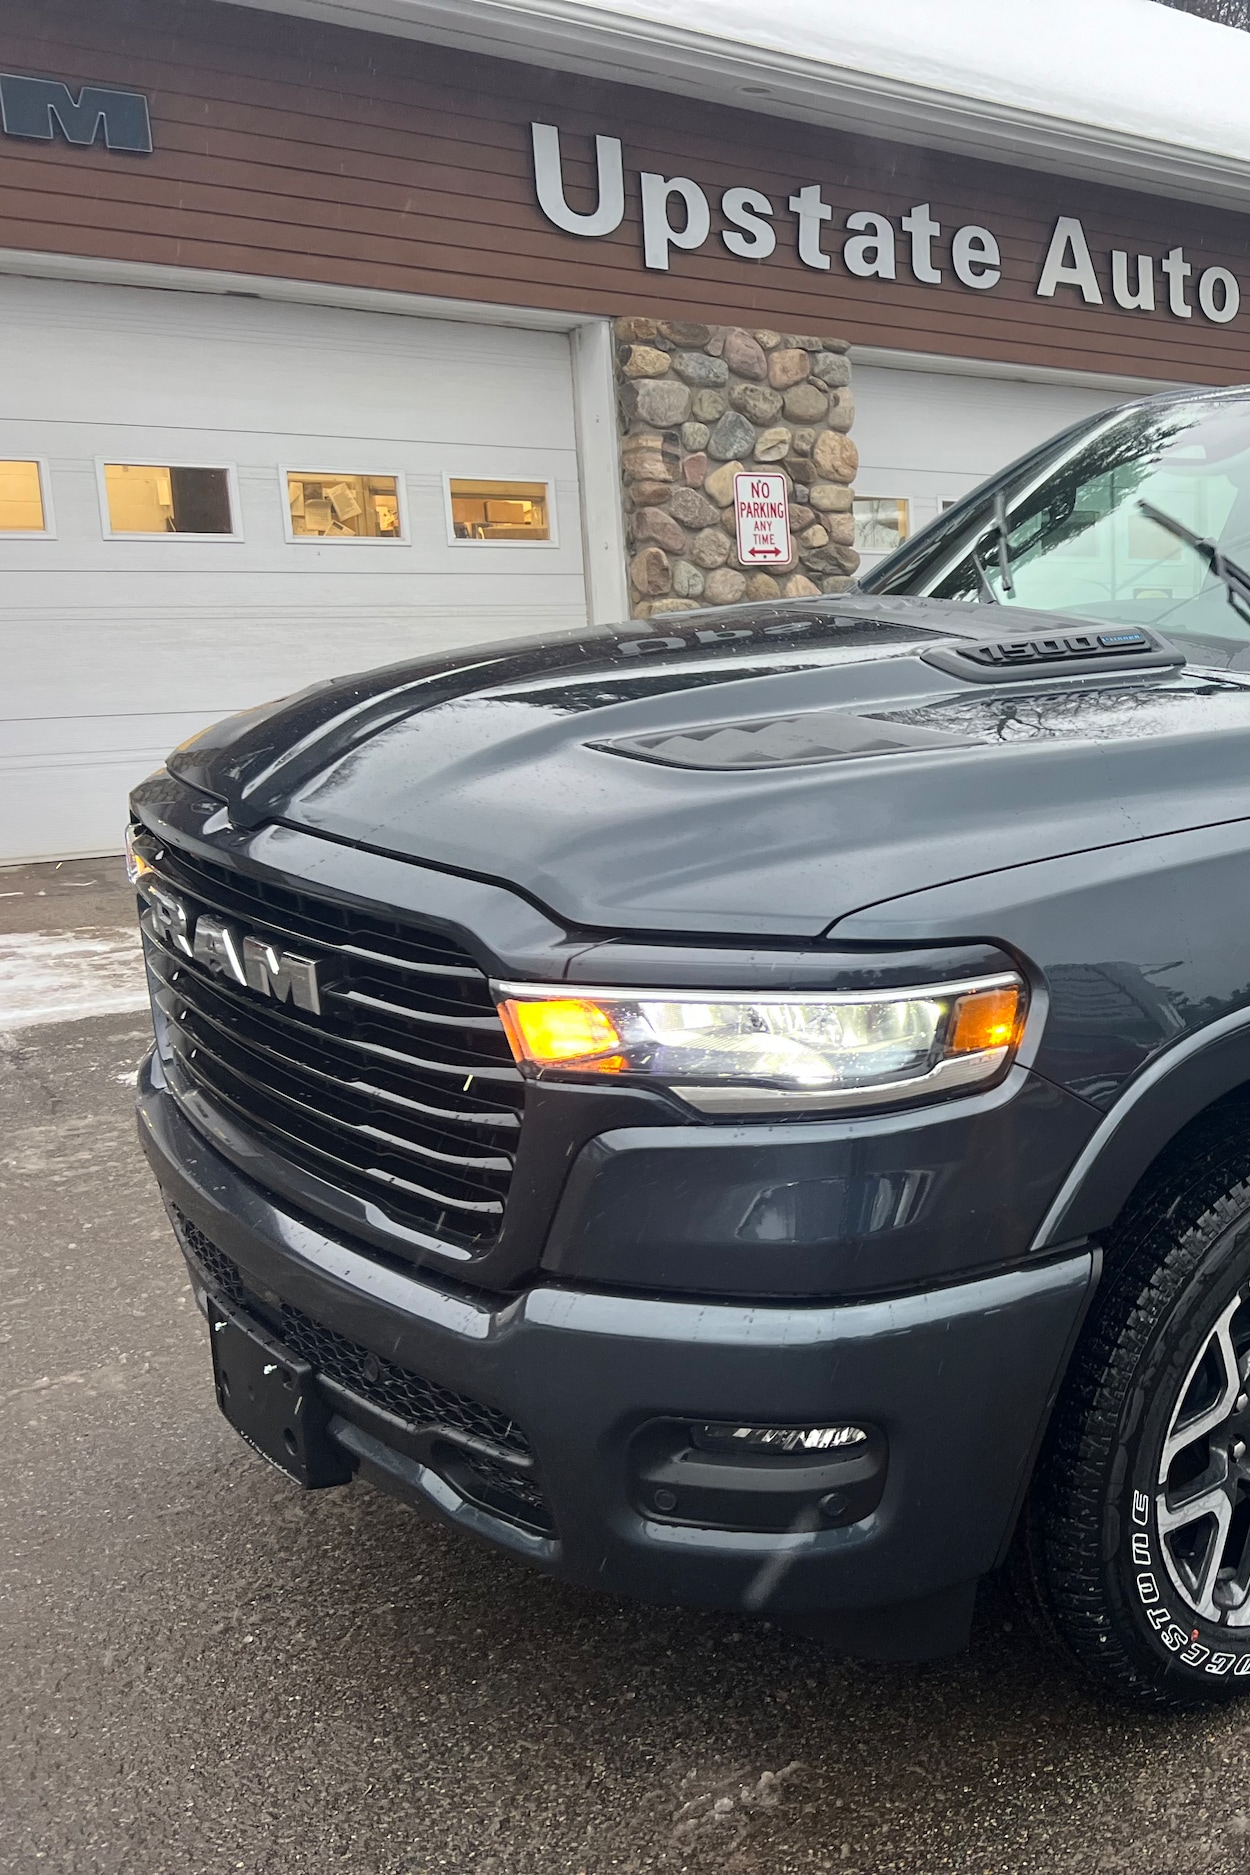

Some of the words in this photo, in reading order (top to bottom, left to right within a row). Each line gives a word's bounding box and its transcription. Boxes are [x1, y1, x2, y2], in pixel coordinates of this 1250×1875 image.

[531, 121, 1001, 290] Upstate
[1036, 215, 1241, 324] Auto
[751, 482, 770, 499] NO
[740, 502, 784, 518] PARKING
[754, 521, 772, 531] ANY
[753, 534, 775, 545] TIME
[978, 637, 1100, 661] 1500
[148, 885, 322, 1016] RAM
